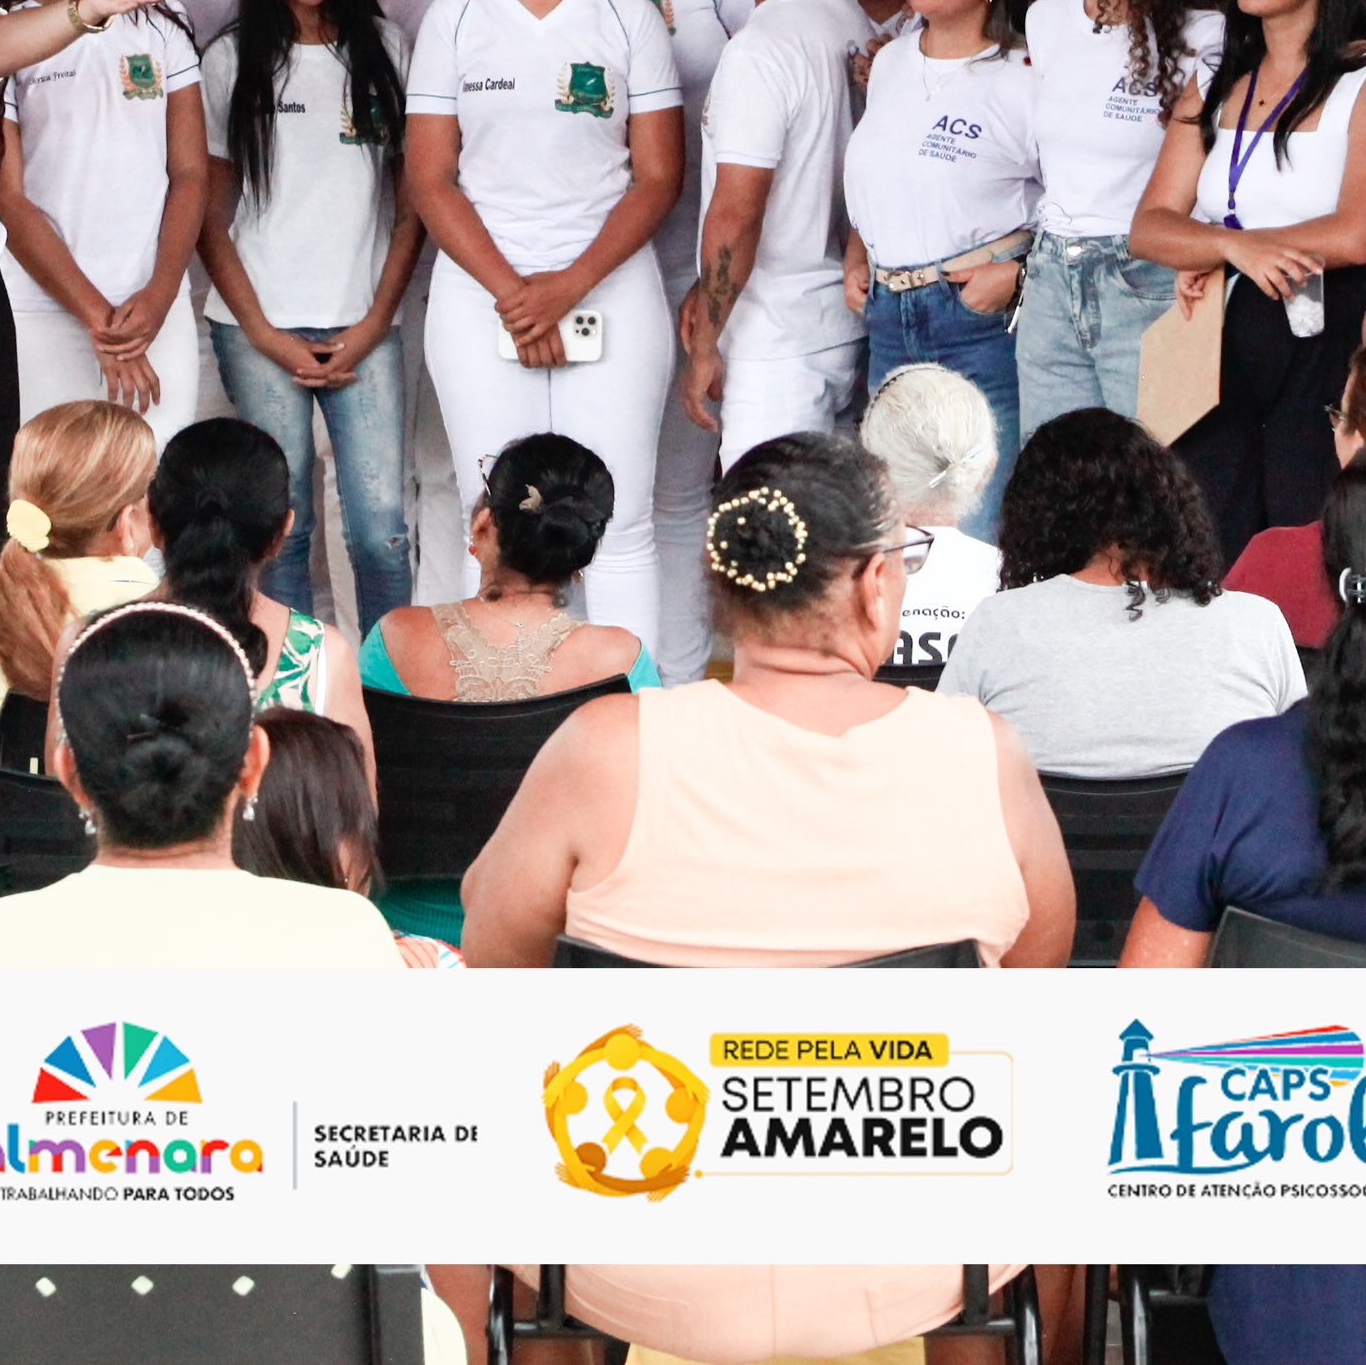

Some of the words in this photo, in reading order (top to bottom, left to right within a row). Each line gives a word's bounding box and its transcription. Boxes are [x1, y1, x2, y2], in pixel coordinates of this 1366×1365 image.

[485, 78, 515, 90] Cardeal
[1112, 76, 1158, 97] ACS
[278, 101, 306, 113] Santos
[1108, 96, 1138, 106] AGENTE
[932, 115, 982, 139] ACS
[902, 605, 965, 620] enação:
